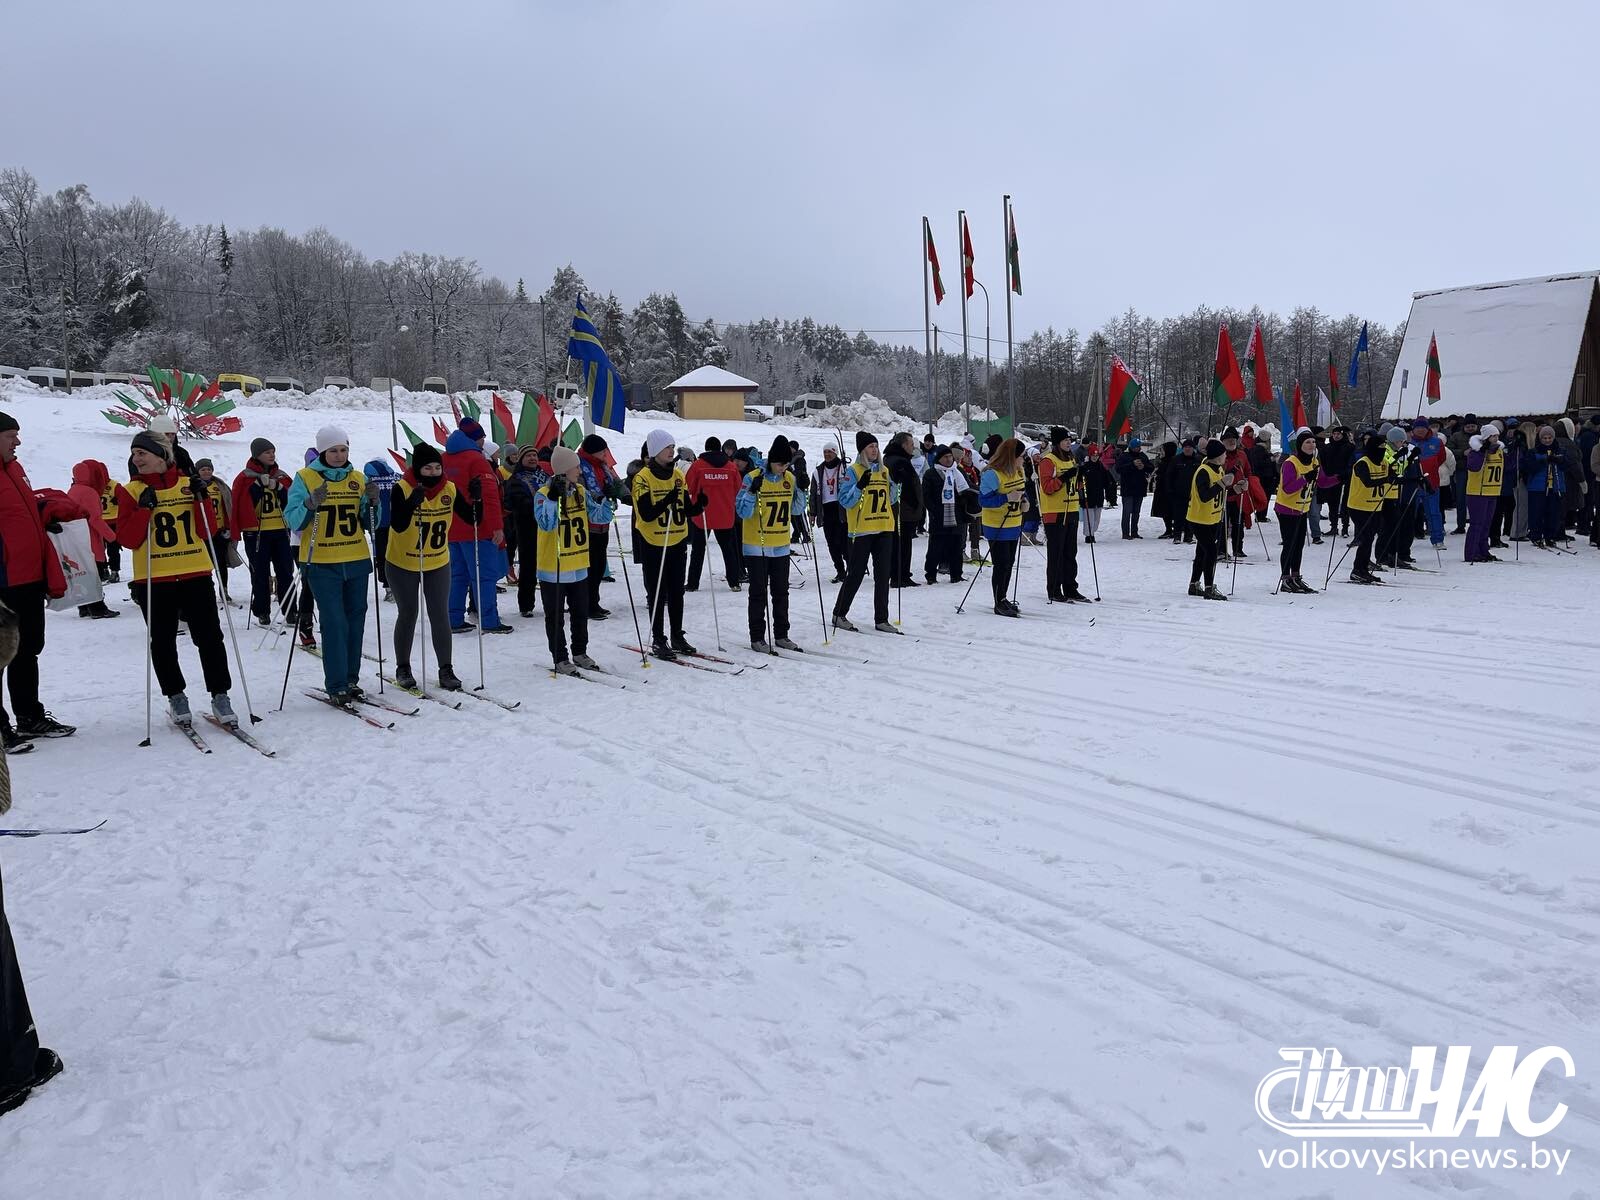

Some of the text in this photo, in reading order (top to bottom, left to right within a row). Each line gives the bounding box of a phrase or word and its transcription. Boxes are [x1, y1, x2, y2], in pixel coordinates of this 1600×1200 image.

[1488, 466, 1501, 482] 70
[766, 501, 789, 527] 74
[868, 489, 887, 513] 72
[154, 510, 195, 548] 81
[317, 504, 358, 538] 75
[415, 520, 447, 550] 78
[560, 516, 587, 548] 73
